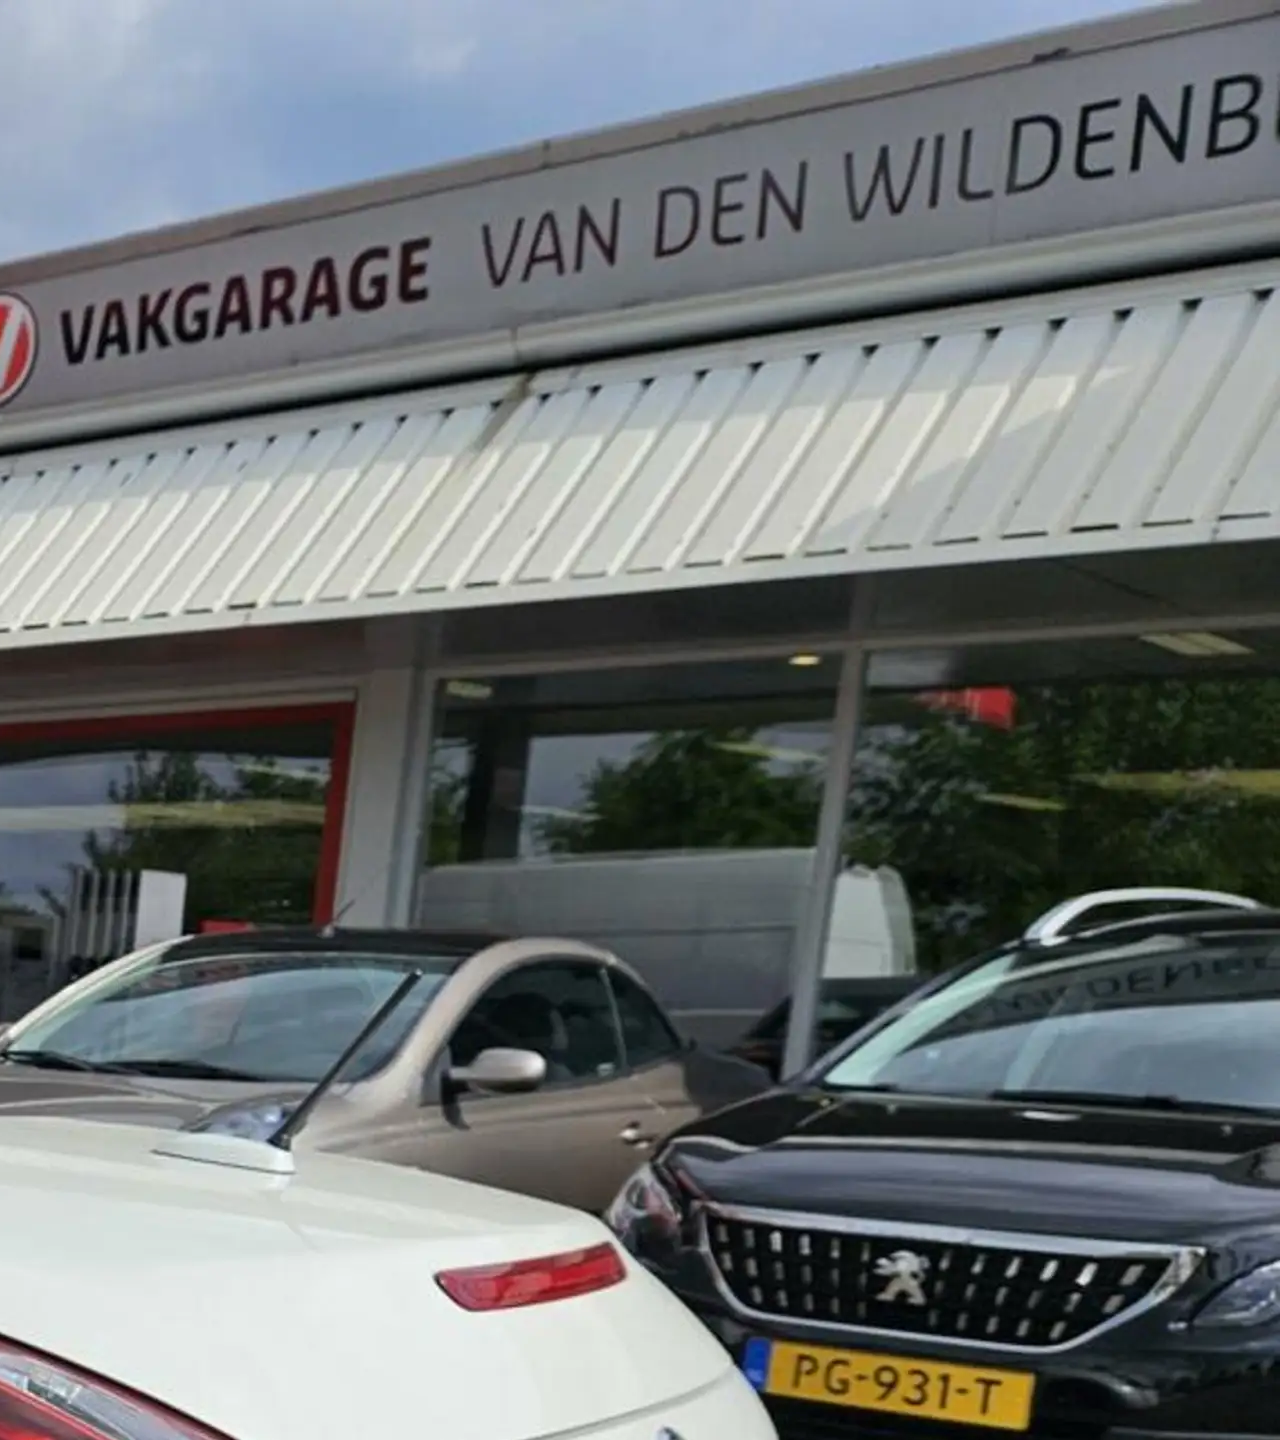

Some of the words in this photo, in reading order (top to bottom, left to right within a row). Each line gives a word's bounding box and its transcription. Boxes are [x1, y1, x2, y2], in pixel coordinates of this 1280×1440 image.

[60, 236, 431, 366] VAKGARAGE
[481, 197, 622, 288] VAN
[653, 160, 809, 259] DEN
[843, 73, 1280, 222] WILDENB
[792, 1353, 1002, 1416] PG-931-T
